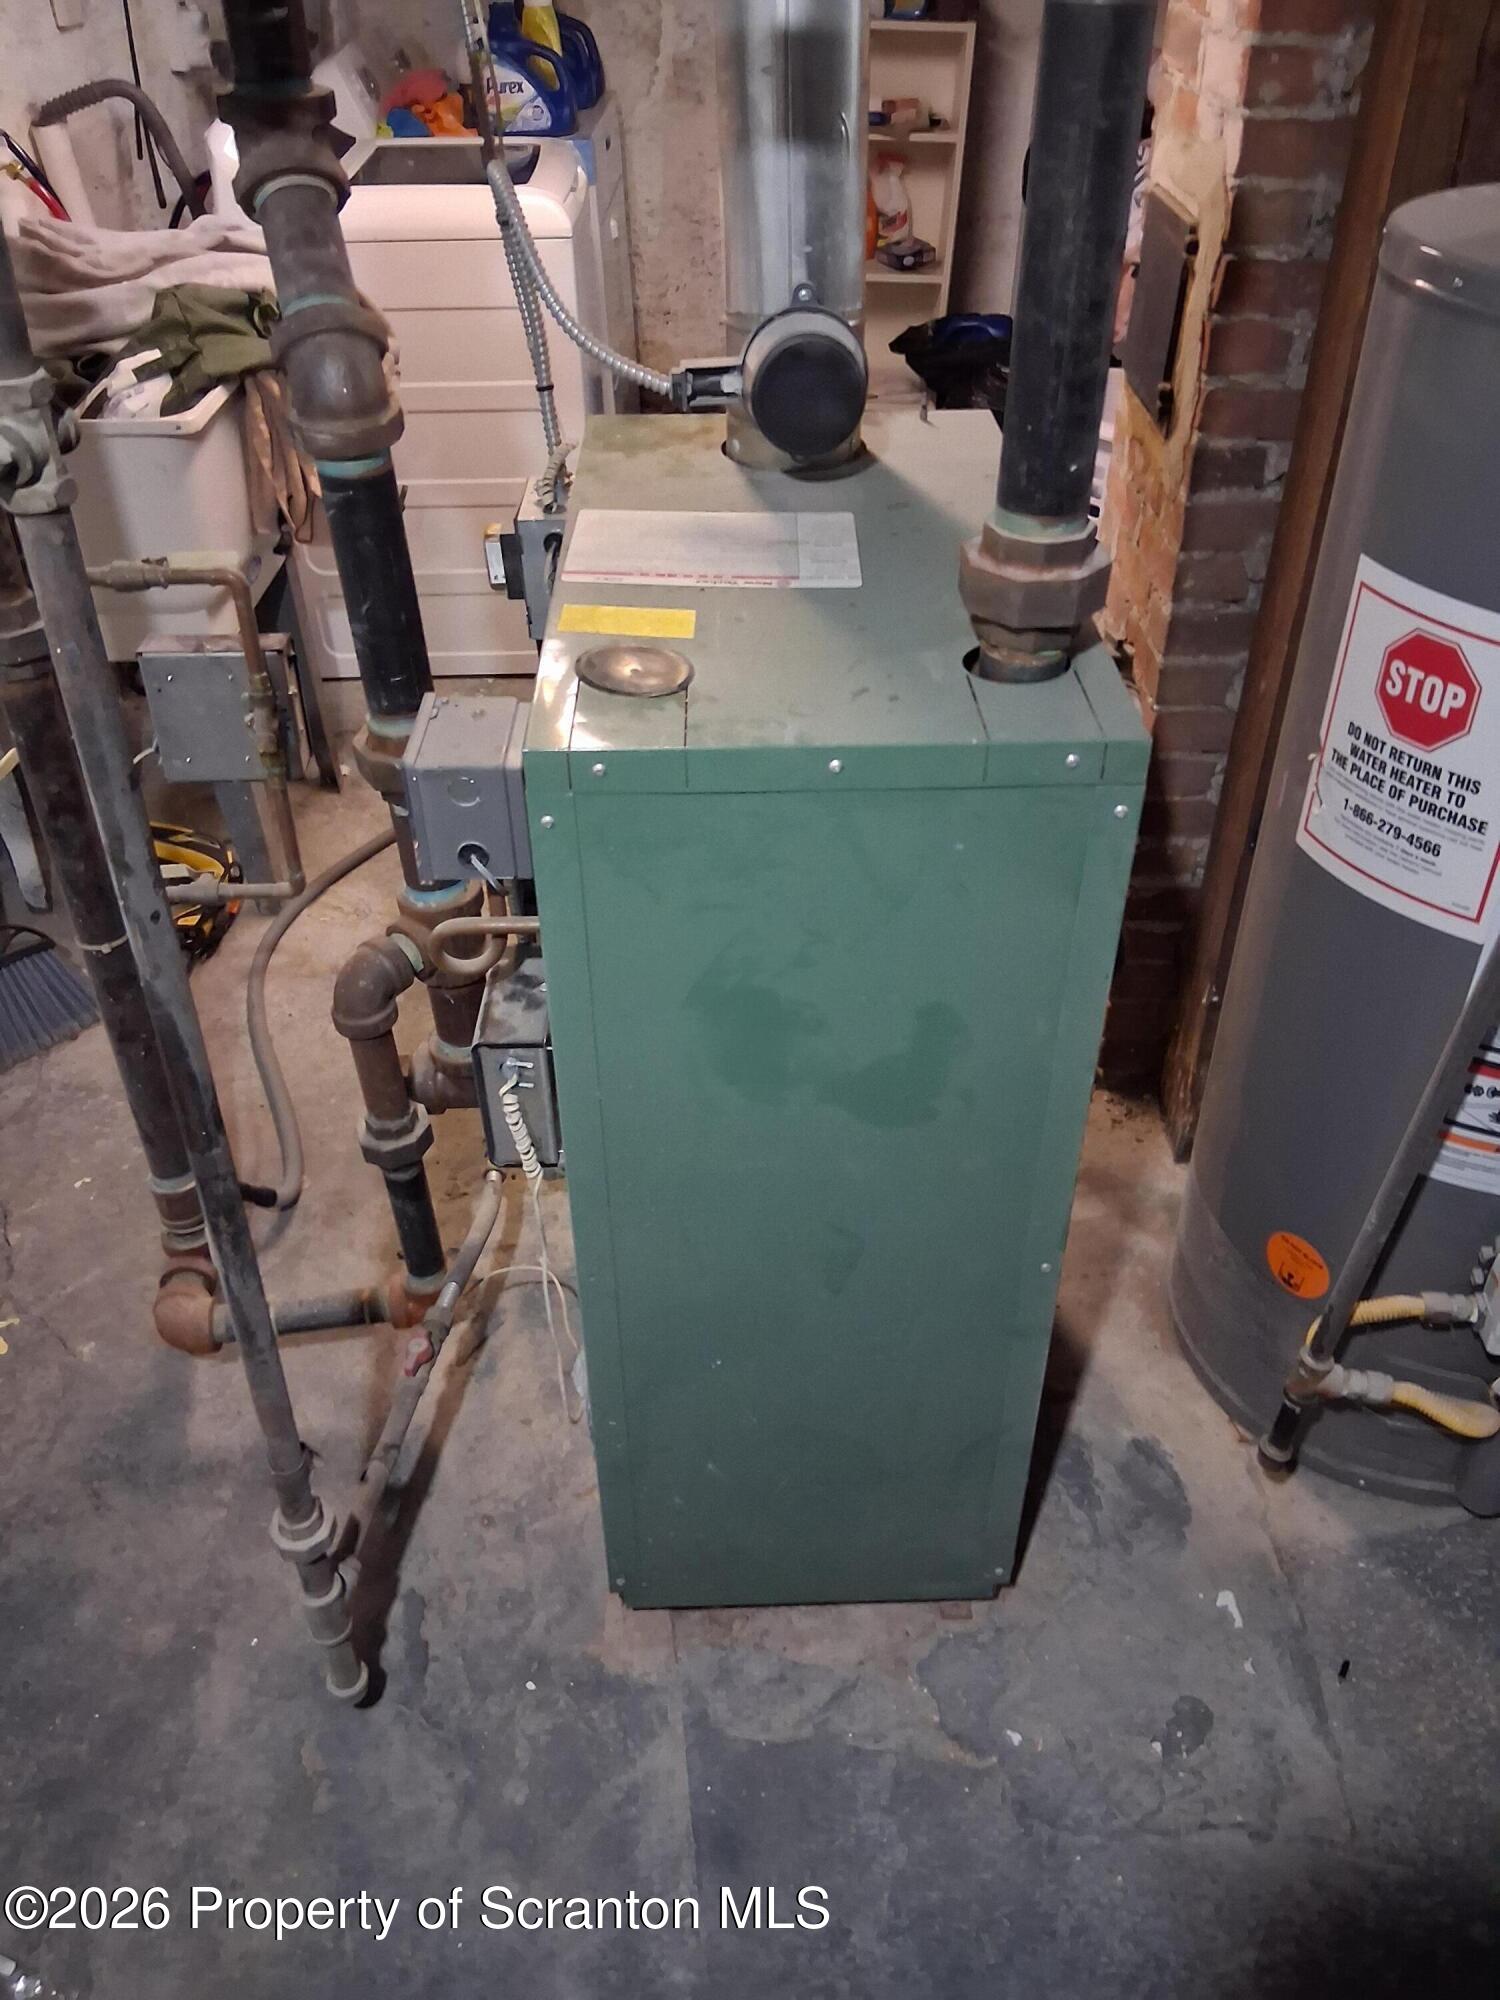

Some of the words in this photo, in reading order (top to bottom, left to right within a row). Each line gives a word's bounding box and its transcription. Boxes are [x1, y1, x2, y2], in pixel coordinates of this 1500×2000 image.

[1385, 659, 1467, 718] STOP
[1347, 721, 1362, 741] DO
[1363, 732, 1387, 755] NOT
[1389, 746, 1443, 781] RETURN
[1447, 771, 1482, 795] THIS
[1350, 743, 1387, 774] WATER
[1389, 766, 1442, 800] HEATER
[1447, 791, 1466, 809] TO
[1331, 749, 1348, 771] THE
[1349, 763, 1385, 794] PLACE
[1388, 785, 1405, 802] OF
[1408, 795, 1489, 836] PURCHASE
[1343, 798, 1442, 857] 1-866-279-4566
